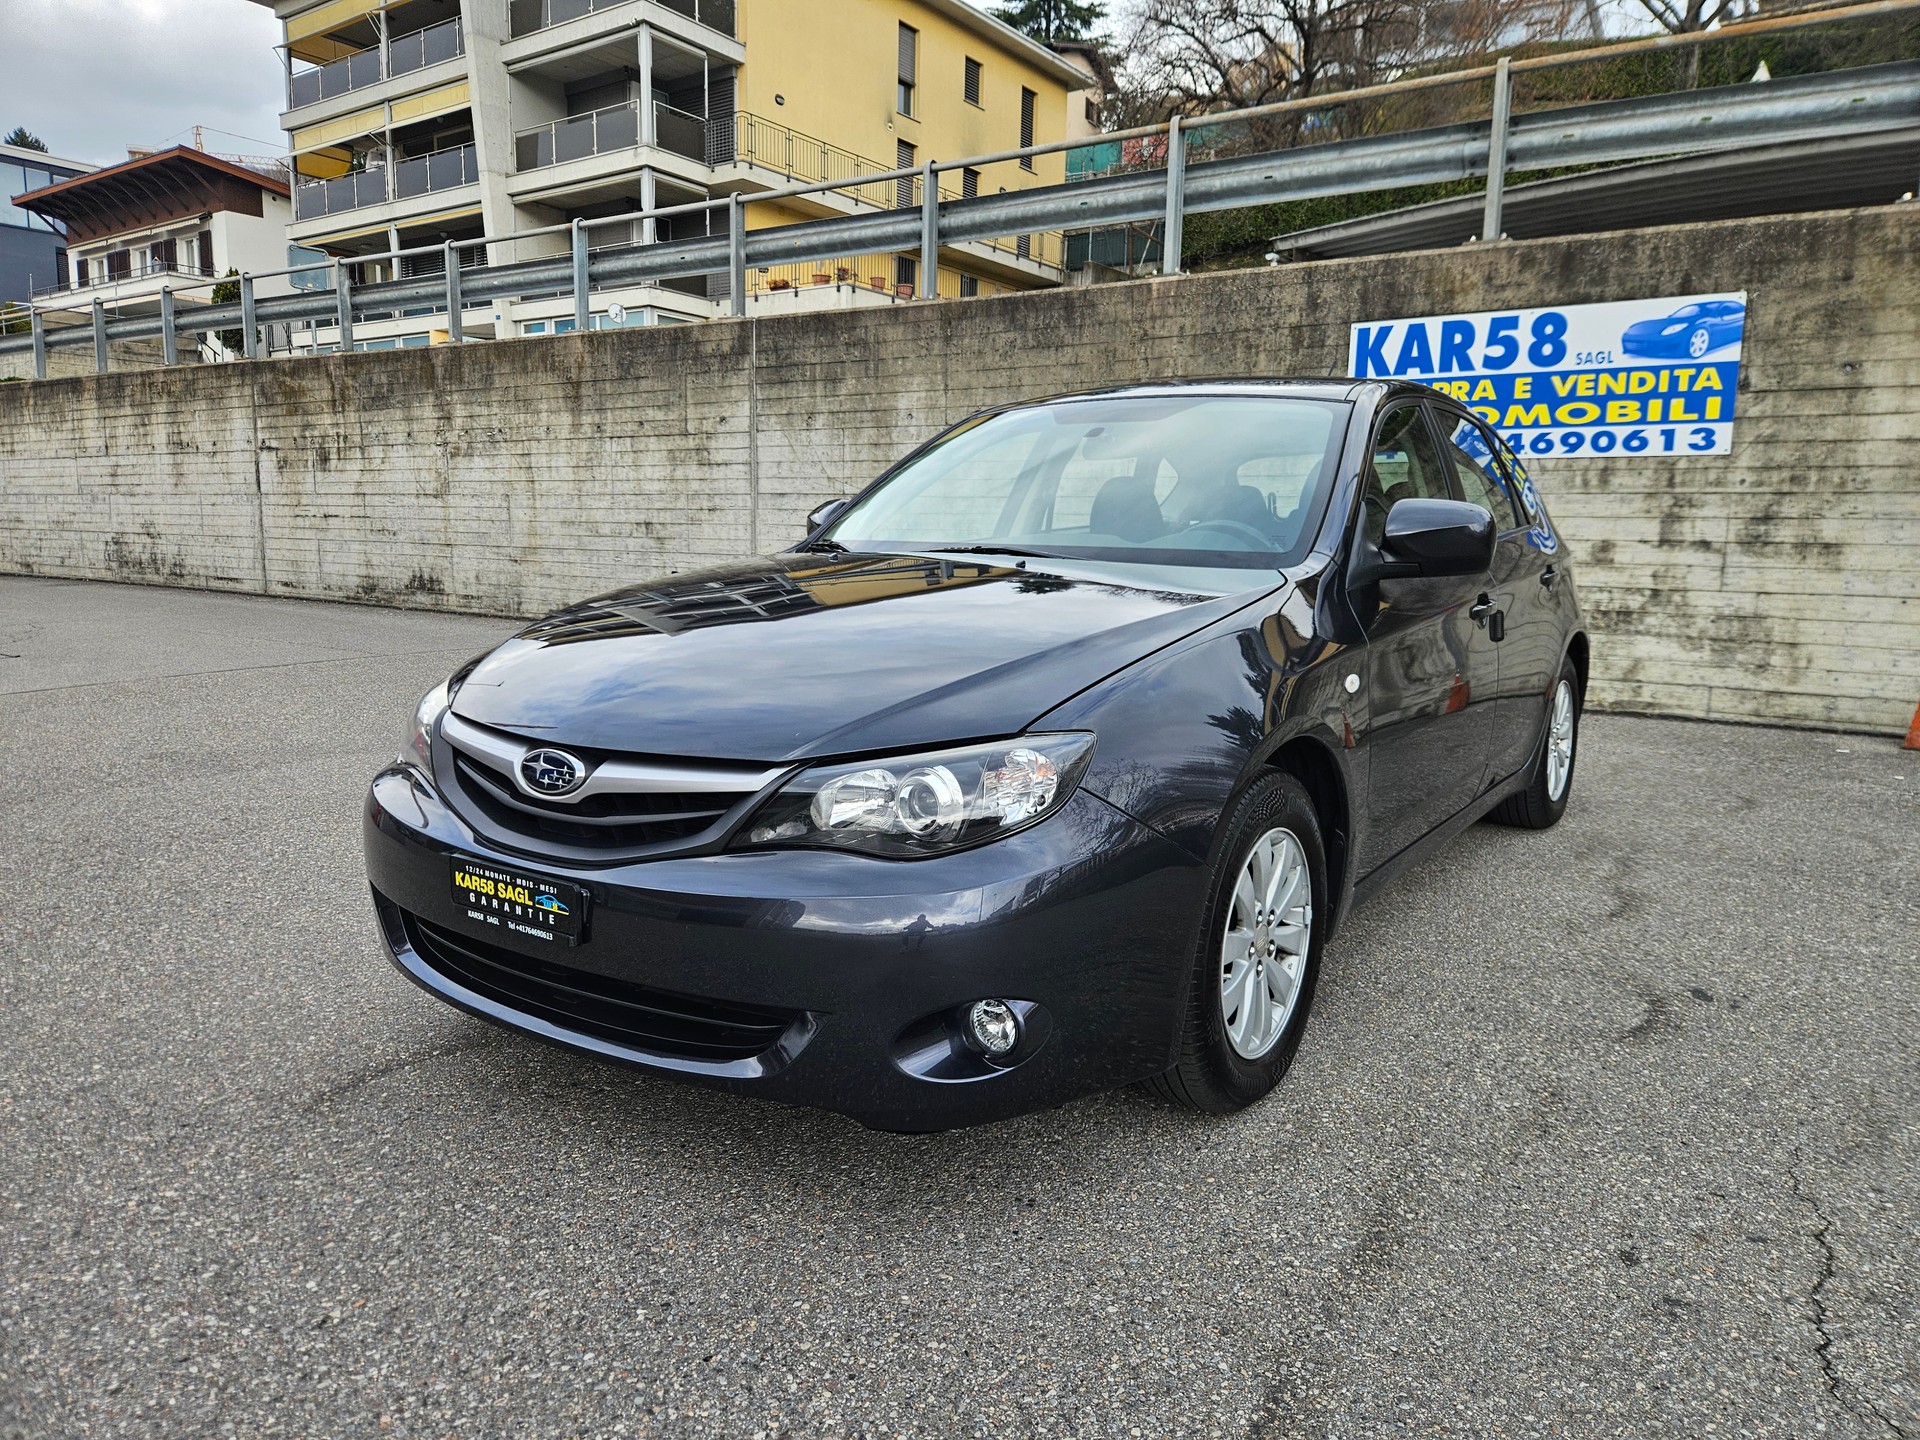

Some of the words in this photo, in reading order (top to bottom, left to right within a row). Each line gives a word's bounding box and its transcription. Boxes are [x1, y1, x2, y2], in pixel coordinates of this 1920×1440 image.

[1355, 312, 1568, 378] KAR58
[1575, 350, 1614, 366] SAGL
[1426, 378, 1497, 401] PRA
[1513, 376, 1533, 399] E
[1551, 367, 1723, 398] VENDITA
[1468, 396, 1722, 427] OMOBILI
[1507, 427, 1716, 455] 4690613
[455, 871, 495, 896] KAR58
[497, 882, 533, 906] SAGL
[485, 869, 511, 883] MONATE
[469, 892, 555, 925] GARANTIE
